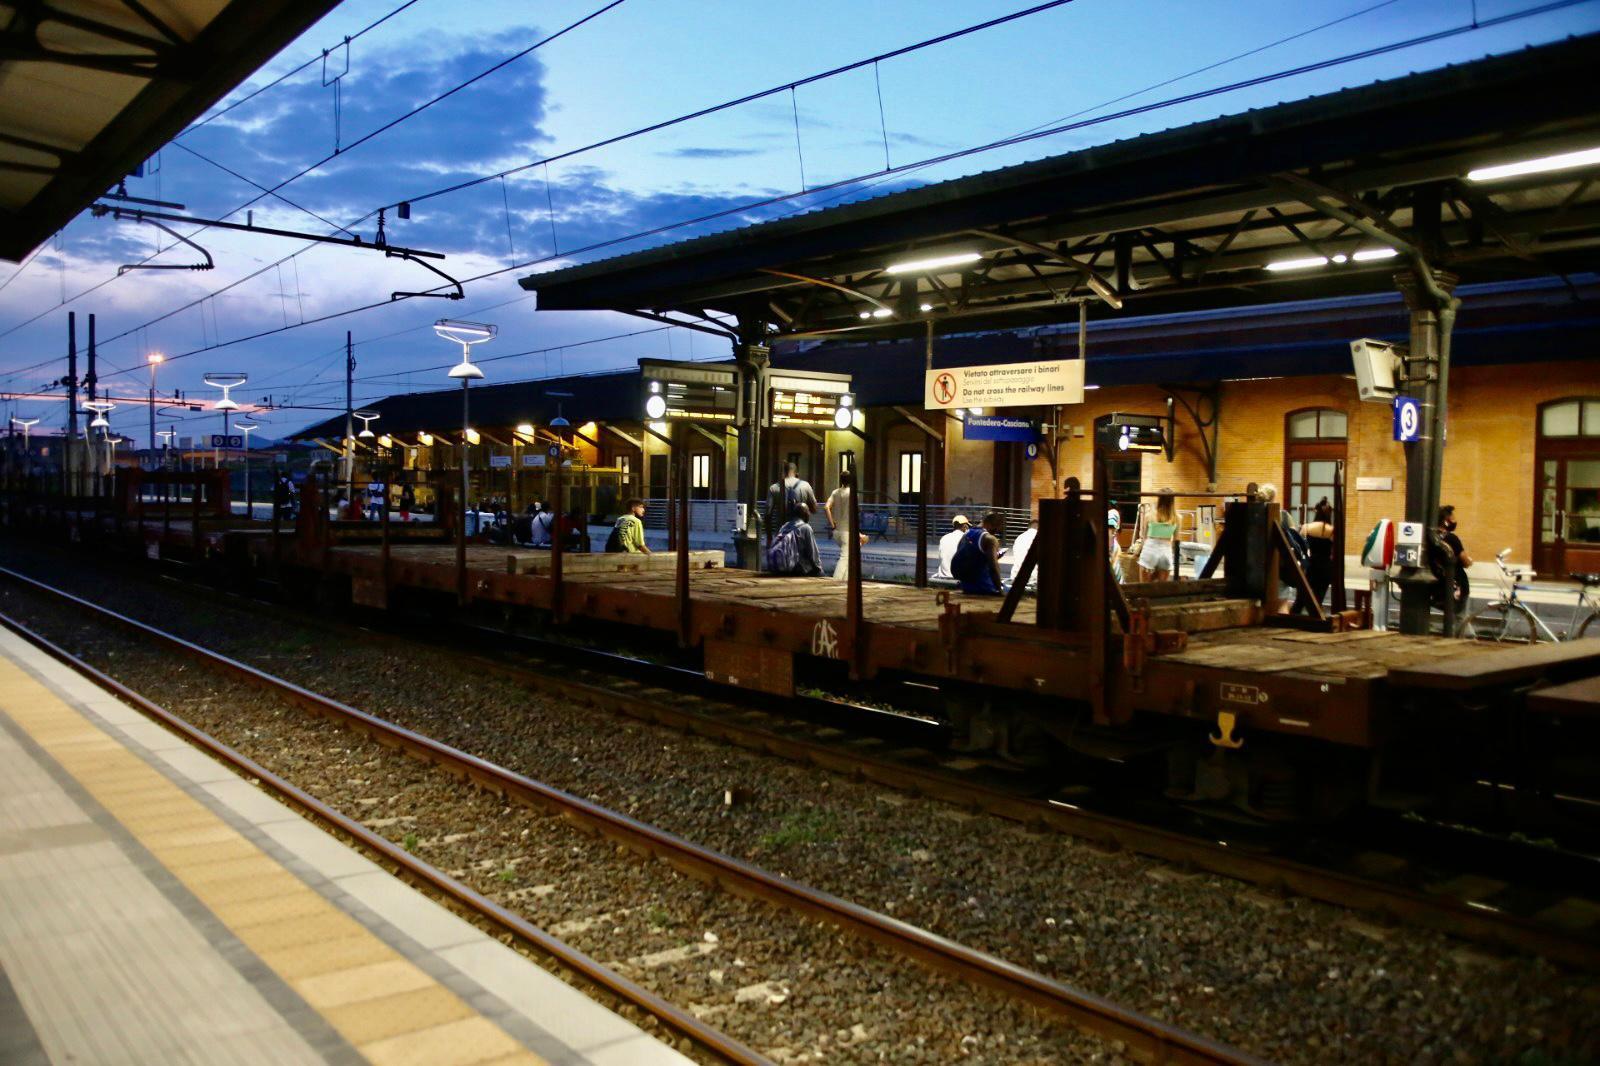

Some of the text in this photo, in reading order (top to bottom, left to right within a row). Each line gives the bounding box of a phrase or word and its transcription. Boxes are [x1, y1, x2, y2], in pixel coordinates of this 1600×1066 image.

[963, 370, 988, 378] Vietato
[989, 368, 1033, 376] attraversare
[1038, 365, 1060, 373] binari
[963, 388, 972, 396] Do
[1005, 386, 1017, 394] the
[1018, 385, 1045, 394] railway
[1047, 384, 1064, 392] lines
